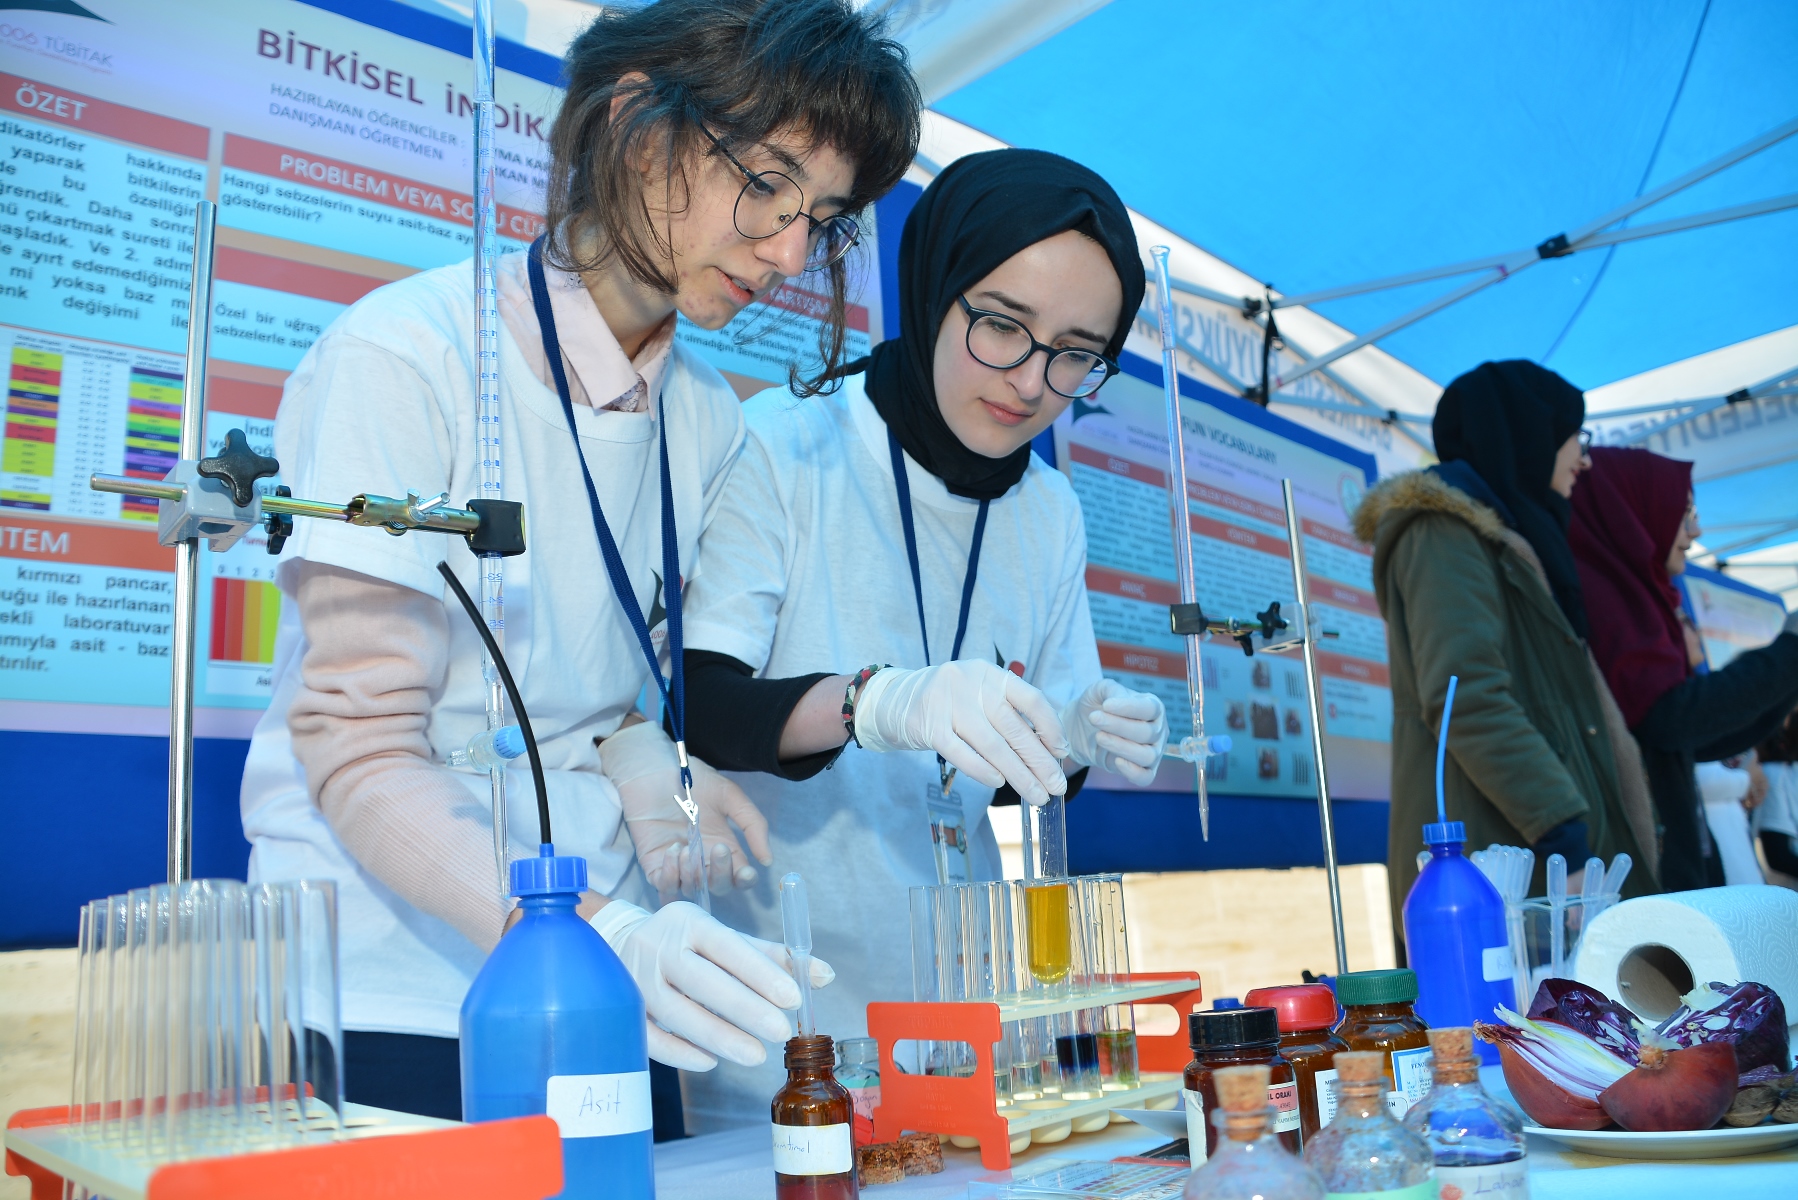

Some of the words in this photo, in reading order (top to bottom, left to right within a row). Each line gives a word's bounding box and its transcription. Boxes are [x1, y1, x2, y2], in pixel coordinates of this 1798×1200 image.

[44, 35, 114, 67] TÜBİTAK
[256, 27, 425, 106] BİTKİSEL
[15, 82, 88, 122] ÖZET
[270, 82, 364, 119] HAZIRLAYAN
[367, 106, 458, 147] ÖĞRENCİLER
[269, 102, 355, 136] DANIŞMAN
[359, 124, 443, 160] ÖĞRETMEN
[0, 120, 87, 153] dikatörler
[125, 152, 203, 182] hakkında
[10, 144, 87, 173] yaparak
[127, 171, 202, 200] bitkilerin
[62, 173, 87, 191] bu
[220, 191, 323, 223] gösterebilir?
[222, 172, 271, 195] Hangi
[274, 185, 353, 214] sebzelerin
[357, 205, 393, 224] suyu
[396, 217, 451, 239] asit-baz
[279, 153, 389, 198] PROBLEM
[393, 182, 446, 214] VEYA
[449, 198, 507, 229] SOU
[88, 199, 134, 222] Daha
[25, 208, 116, 237] çıkartmak
[121, 229, 171, 251] sureti
[176, 239, 195, 255] ile
[89, 239, 113, 257] Ve
[124, 247, 140, 263] 2.
[10, 265, 34, 281] mi
[51, 274, 107, 295] yoksa
[124, 286, 156, 305] baz
[21, 248, 64, 267] ayırt
[71, 259, 192, 293] edemediğimiz
[63, 296, 140, 321] değişimi
[171, 314, 189, 330] ile
[214, 301, 247, 320] Özel
[255, 310, 275, 325] bir
[283, 317, 322, 336] uğraş
[212, 324, 286, 346] sebzelerle
[16, 565, 82, 585] kırmızı
[105, 575, 172, 596] pancar,
[46, 589, 69, 607] ile
[75, 592, 171, 614] hazırlanan
[63, 613, 171, 636] laboratuvar
[69, 638, 106, 654] asit
[137, 640, 170, 658] baz
[578, 1079, 621, 1117] Asit
